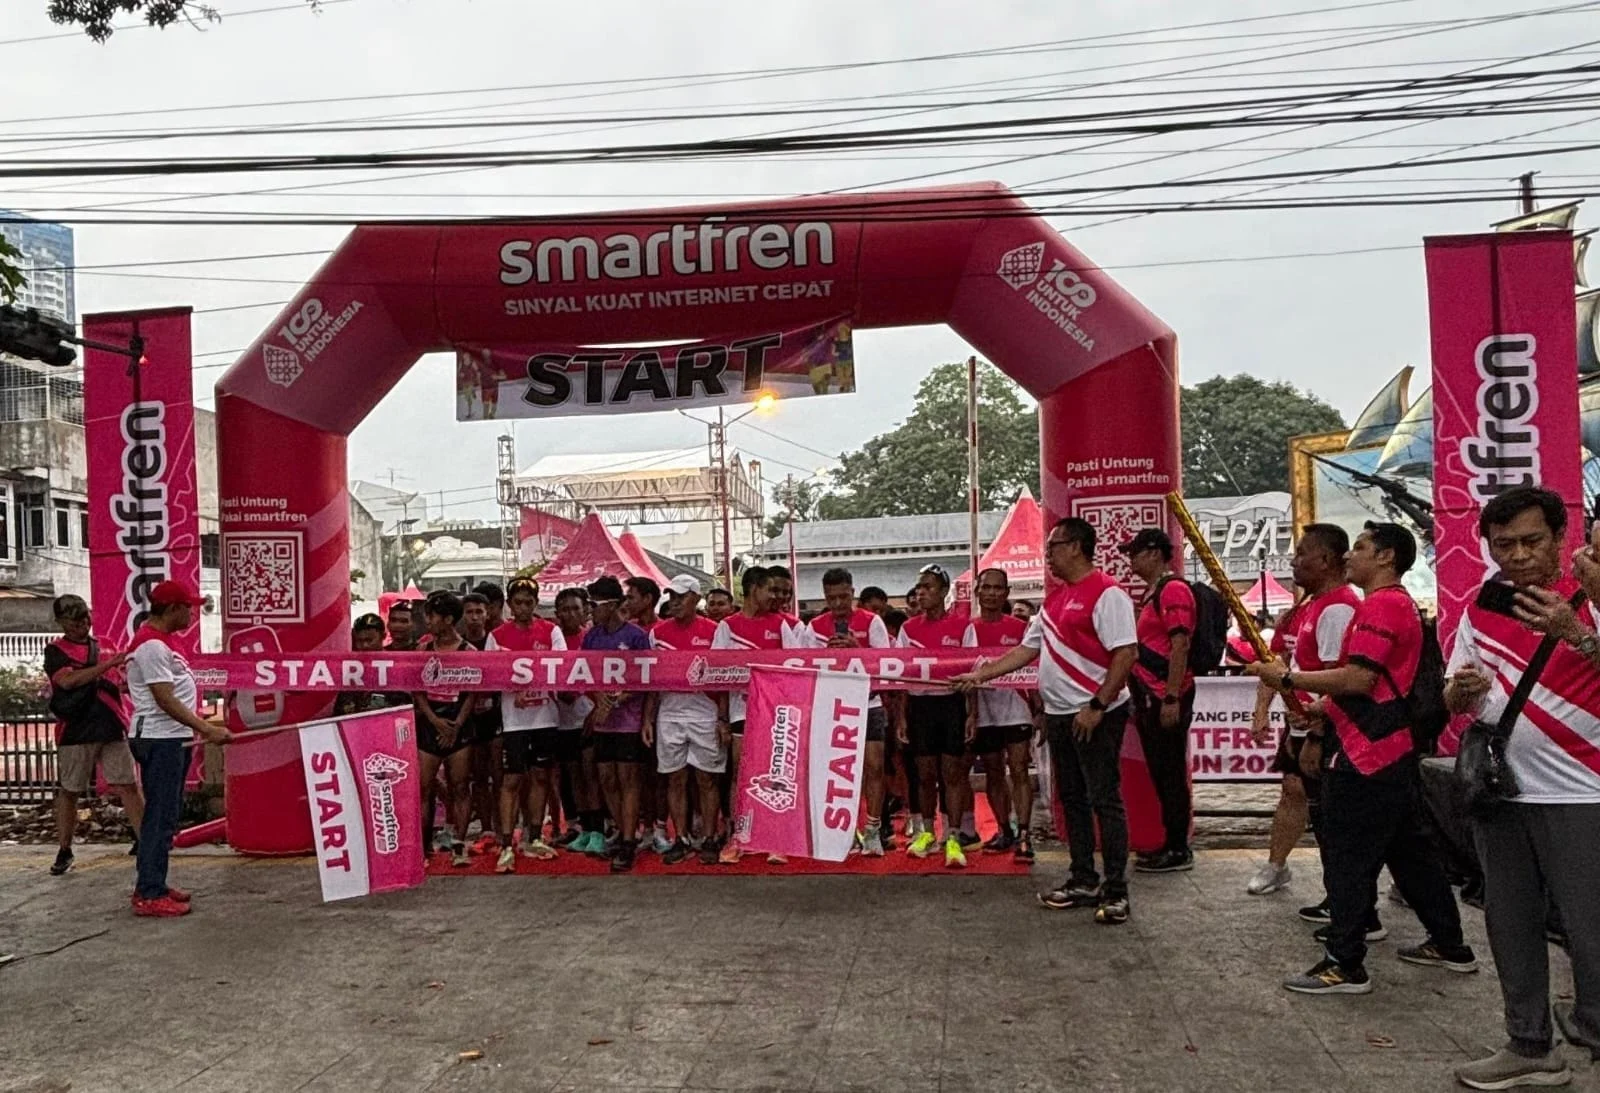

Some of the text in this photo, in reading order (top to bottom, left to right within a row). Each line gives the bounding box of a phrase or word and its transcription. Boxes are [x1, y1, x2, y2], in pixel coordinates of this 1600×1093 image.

[500, 216, 834, 285] smartfren
[505, 280, 834, 316] SINYAL KUAT INTERNET CEPAT
[1036, 279, 1082, 321] UNTUK
[294, 310, 334, 352] UNTUK
[304, 299, 364, 362] INDONESIA
[1025, 289, 1096, 352] INDONESIA
[522, 333, 783, 408] START
[1067, 456, 1154, 473] Pasti Untung
[1067, 471, 1169, 489] Pakai smartfren
[241, 496, 288, 509] Untung
[244, 510, 308, 523] smartfren
[255, 660, 394, 686] START
[511, 657, 658, 685] START
[771, 706, 788, 777] smartfren
[784, 723, 799, 763] RUN
[823, 698, 861, 832] START
[311, 751, 352, 873] START
[370, 797, 387, 836] RUN
[381, 783, 399, 851] smartfren
